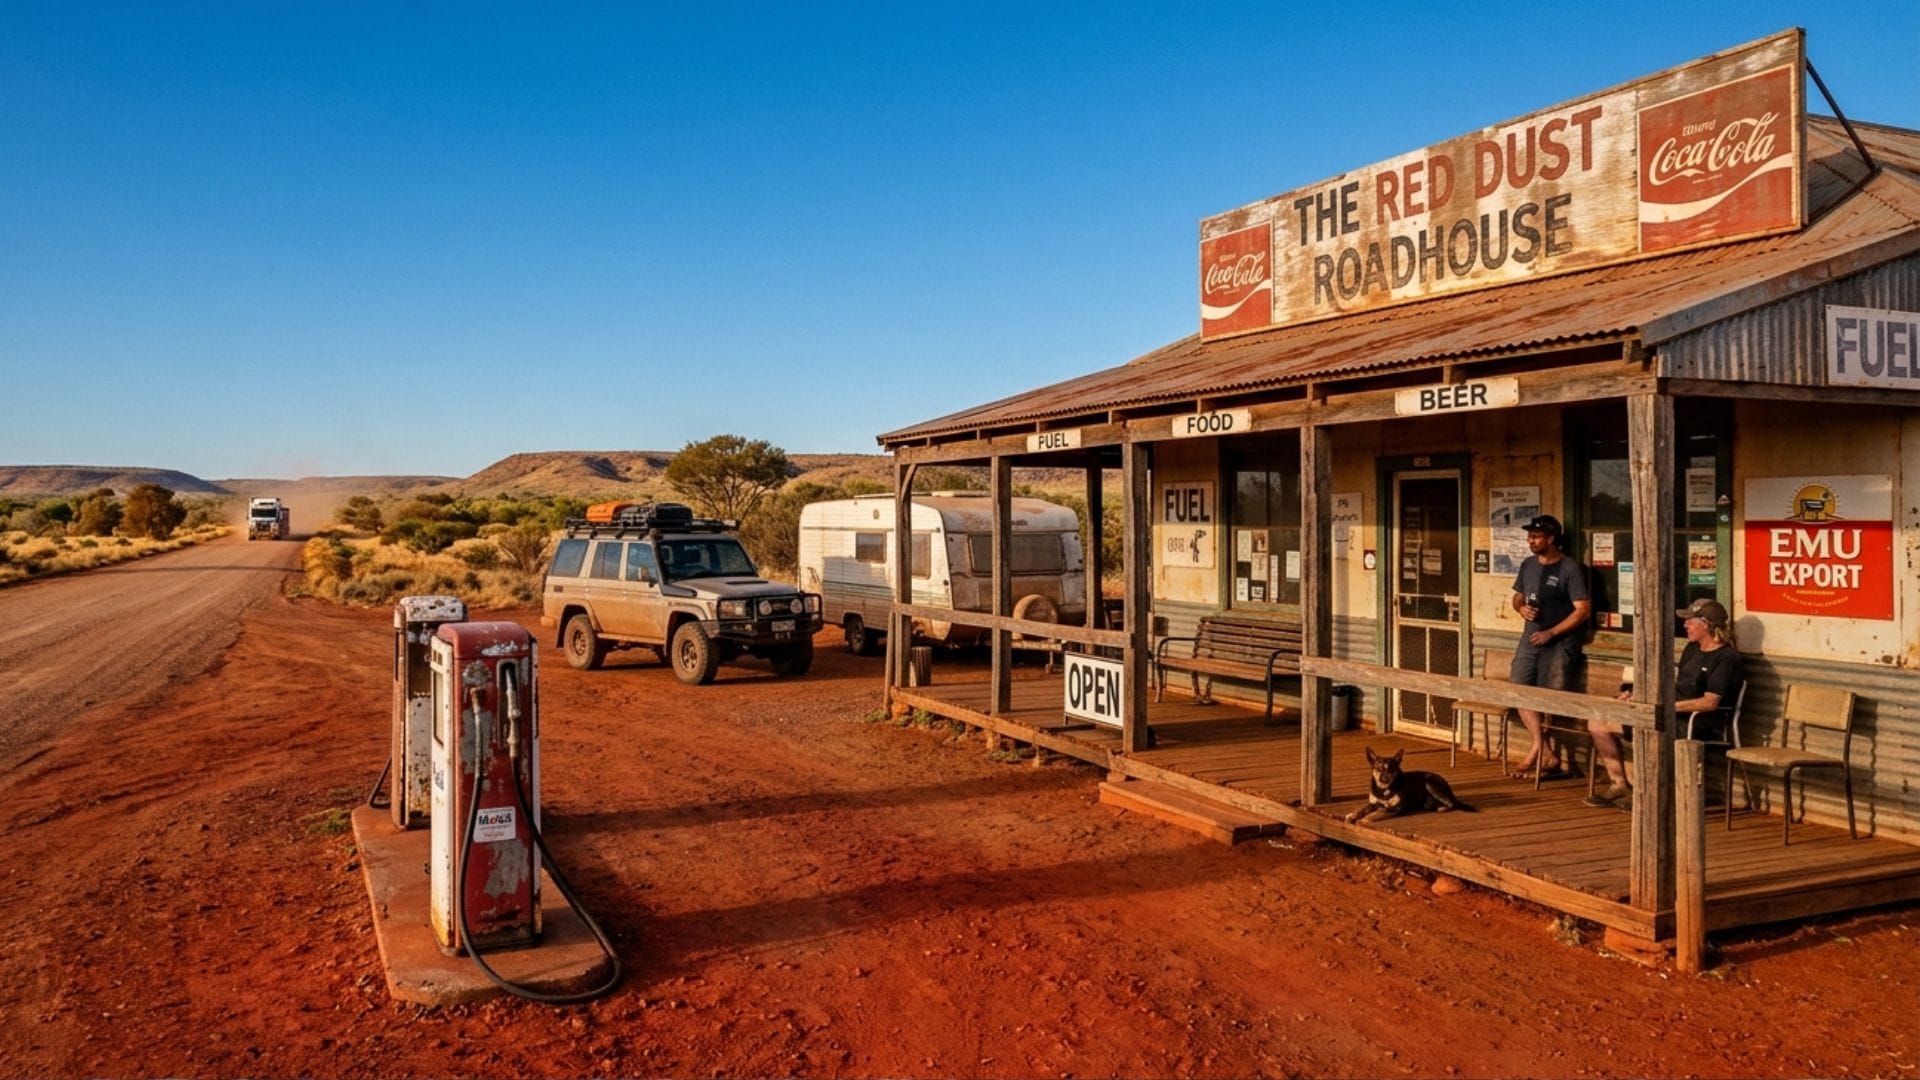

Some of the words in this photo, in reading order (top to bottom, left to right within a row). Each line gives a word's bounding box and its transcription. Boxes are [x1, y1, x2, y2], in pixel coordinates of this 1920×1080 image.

[1649, 112, 1780, 186] Coca-Cola
[1294, 181, 1359, 246] THE
[1376, 154, 1455, 225] RED
[1475, 105, 1602, 199] DUST
[1314, 193, 1573, 310] ROADHOUSE
[1836, 317, 1920, 378] FUEL
[1420, 383, 1488, 411] BEER
[1187, 413, 1233, 434] FOOD
[1165, 488, 1210, 522] FUEL
[1769, 528, 1862, 560] EMU
[1769, 562, 1863, 589] EXPORT
[1069, 662, 1120, 718] OPEN
